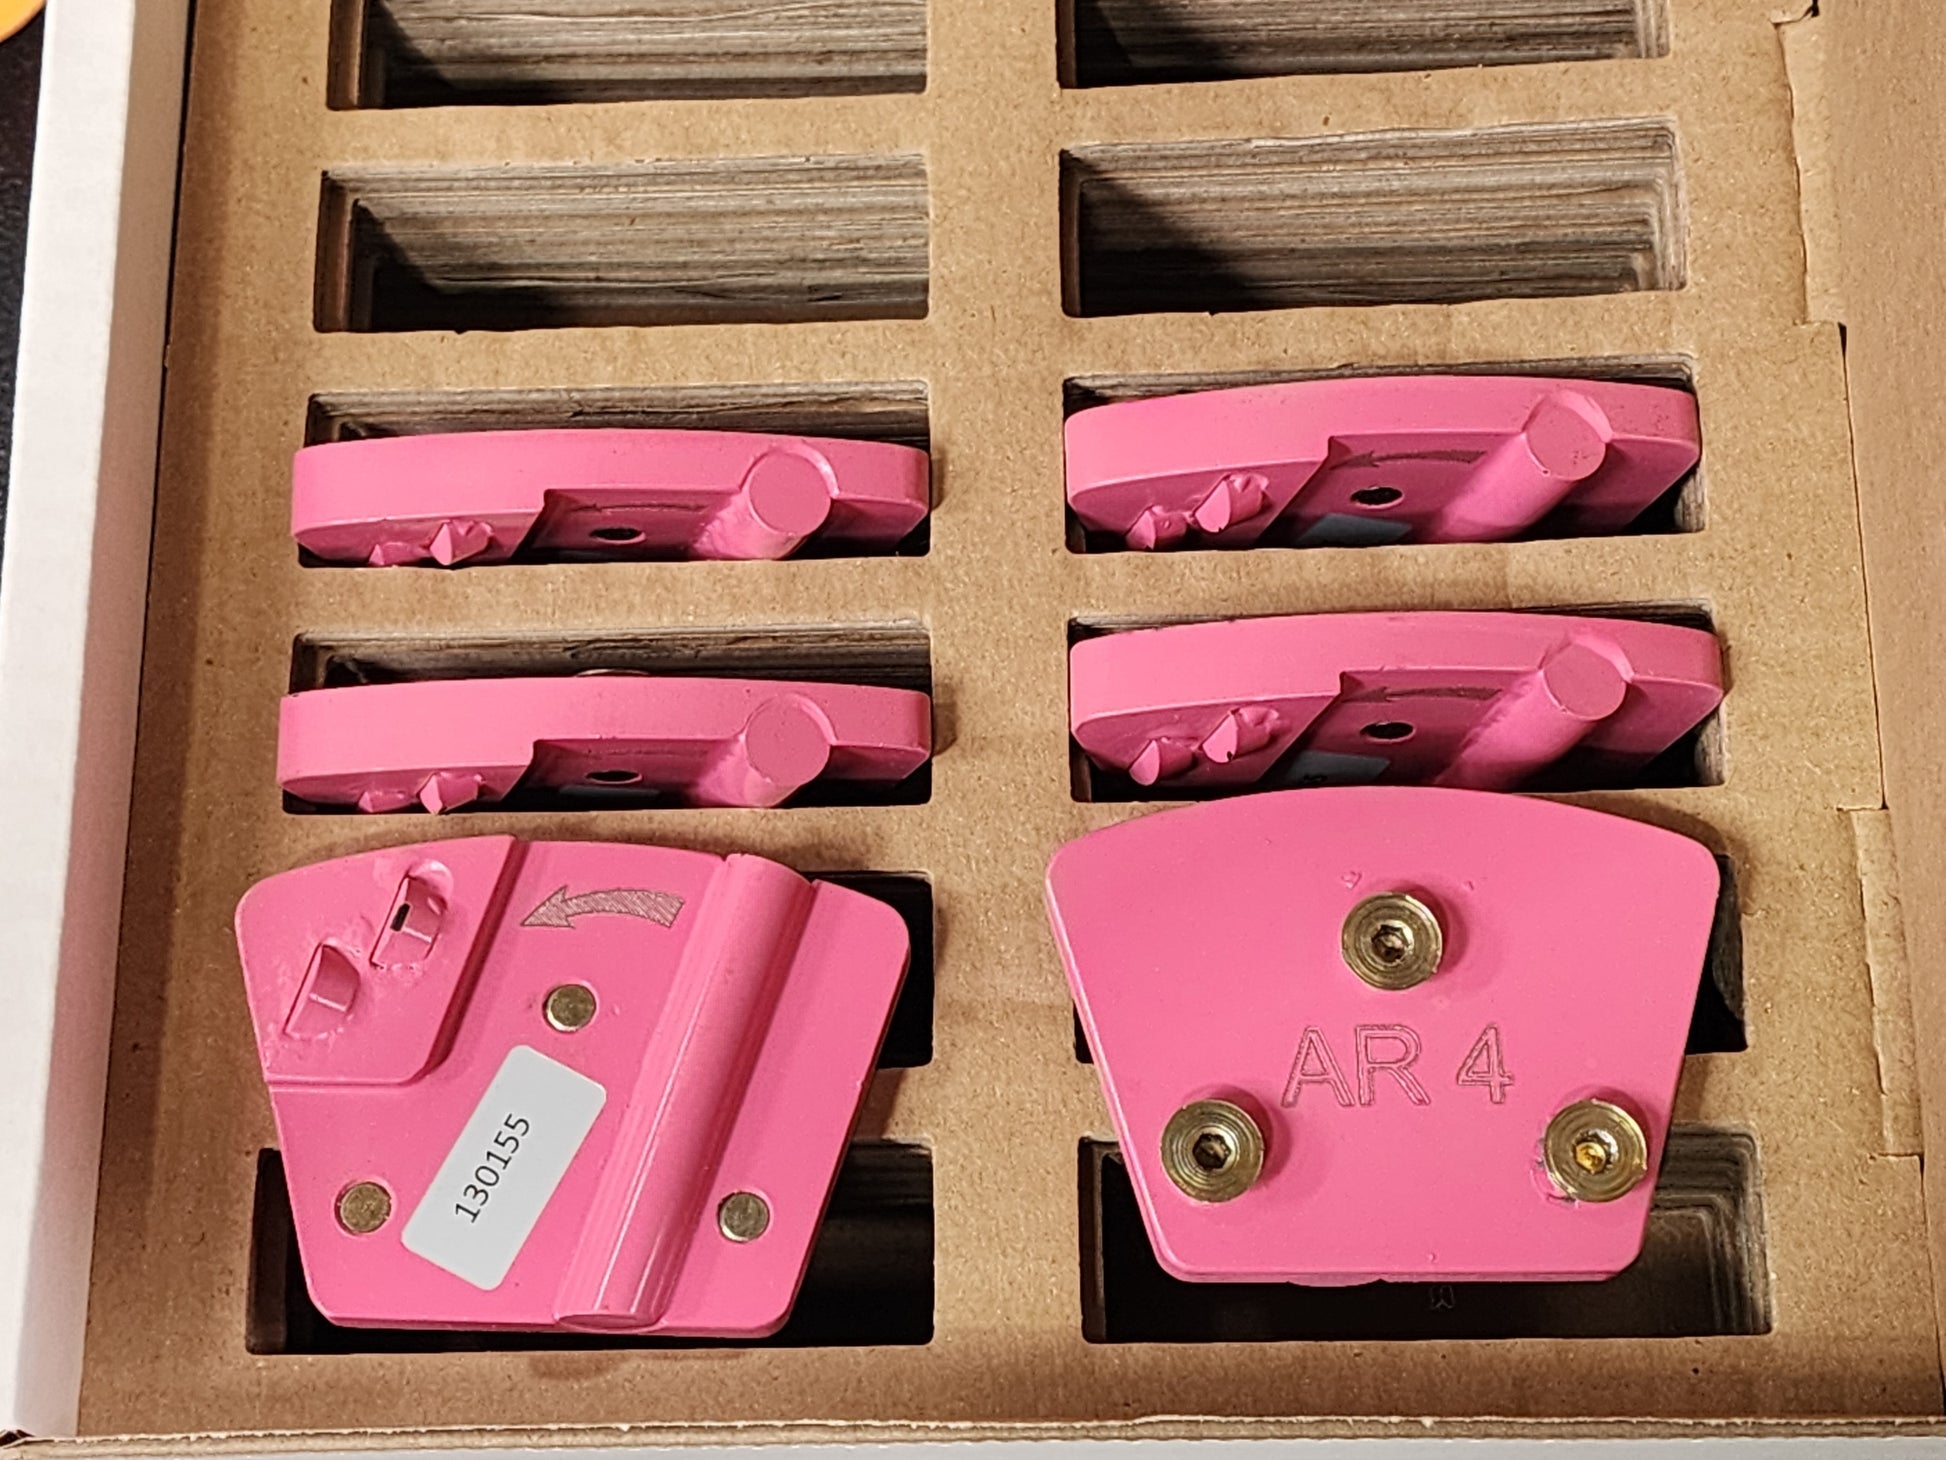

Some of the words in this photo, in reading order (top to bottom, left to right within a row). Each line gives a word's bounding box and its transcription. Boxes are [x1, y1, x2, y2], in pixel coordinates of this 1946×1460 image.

[1281, 1024, 1431, 1107] AR
[1456, 1023, 1515, 1105] 4
[455, 1113, 530, 1223] 130155
